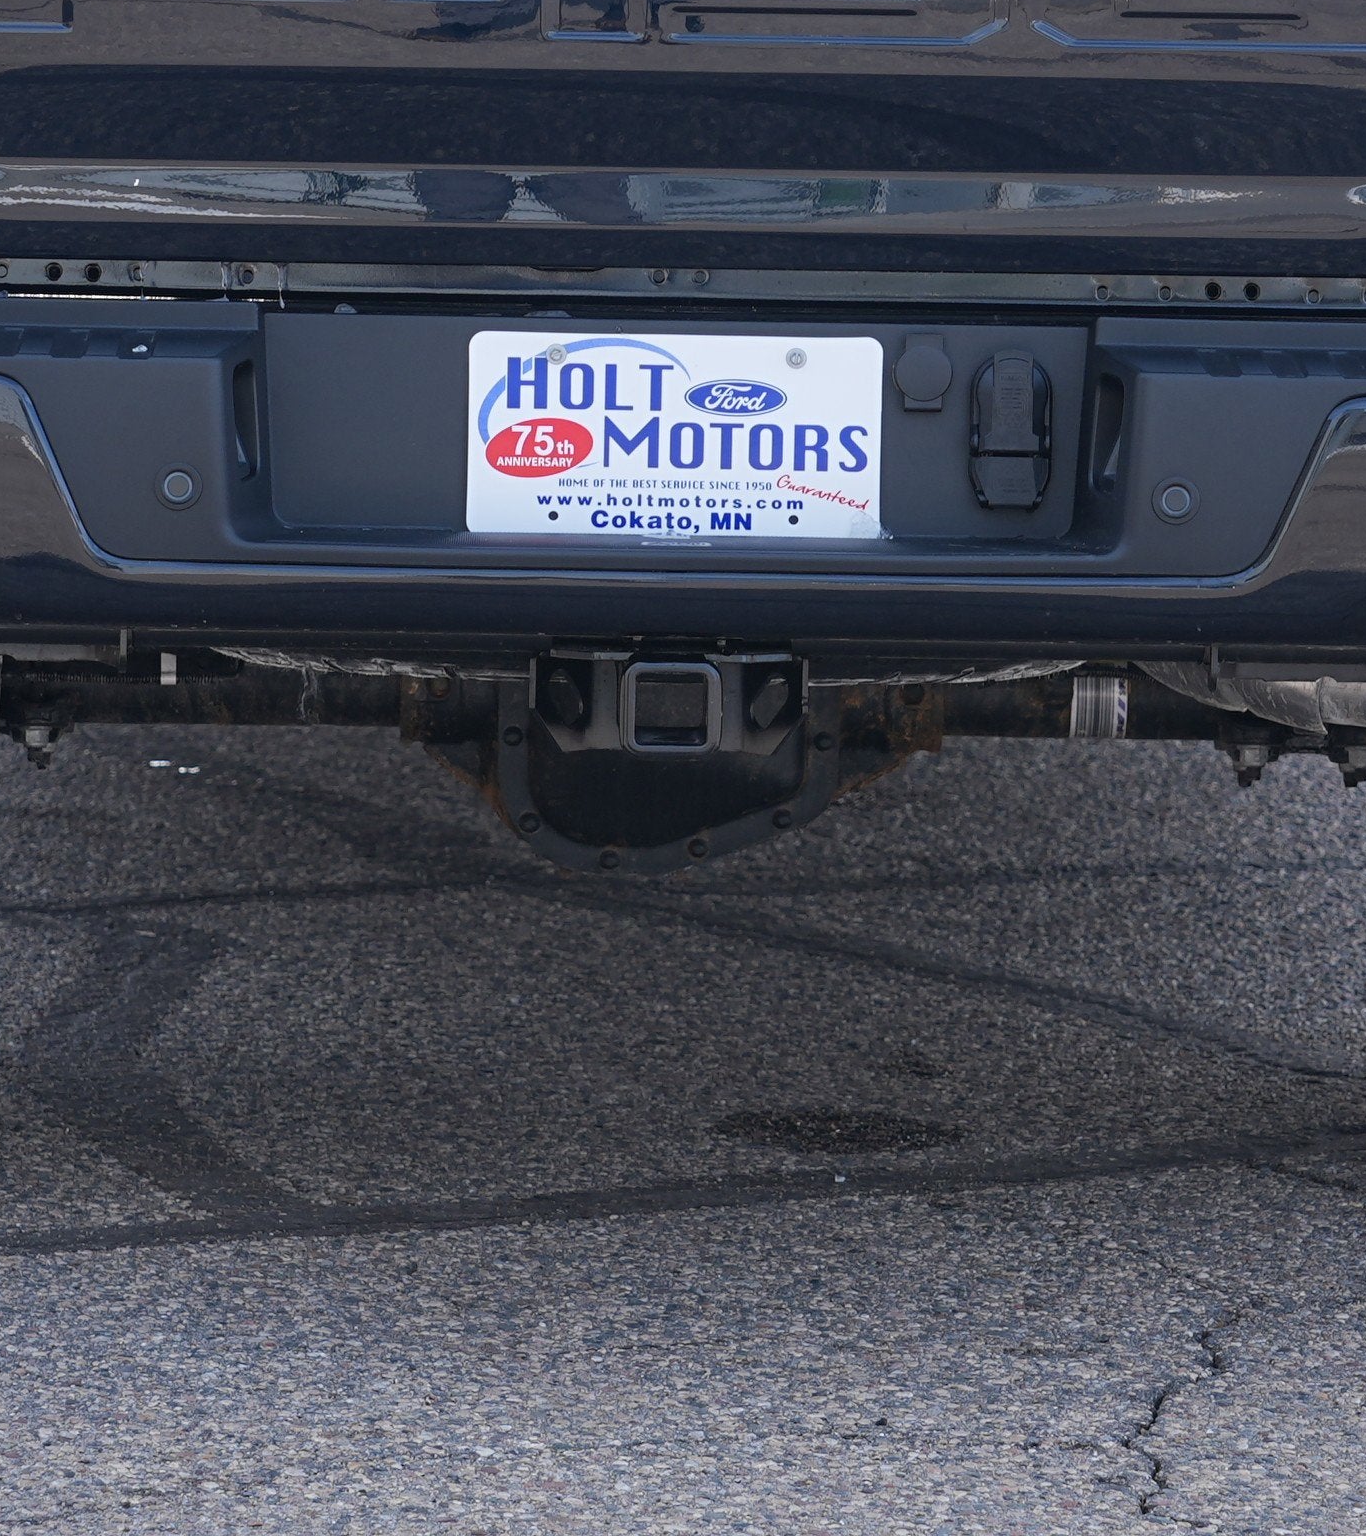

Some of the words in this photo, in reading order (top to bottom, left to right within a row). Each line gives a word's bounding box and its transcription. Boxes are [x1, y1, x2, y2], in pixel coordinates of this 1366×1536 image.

[506, 356, 675, 412] HOLT
[704, 383, 767, 411] Ford
[510, 424, 575, 457] 75th
[603, 415, 870, 473] MOTORS
[496, 455, 574, 469] ANNIVERSARY
[558, 478, 589, 487] HOME
[593, 479, 605, 488] OF
[610, 479, 629, 488] THE
[632, 479, 658, 489] BEST
[661, 480, 706, 490] SERVICE
[709, 481, 741, 491] SINCE
[746, 482, 772, 492] 1950
[776, 474, 870, 512] Guaranteed
[536, 493, 805, 511] www.holtmotors.com
[591, 510, 701, 533] Cokato,
[710, 512, 753, 531] MN
